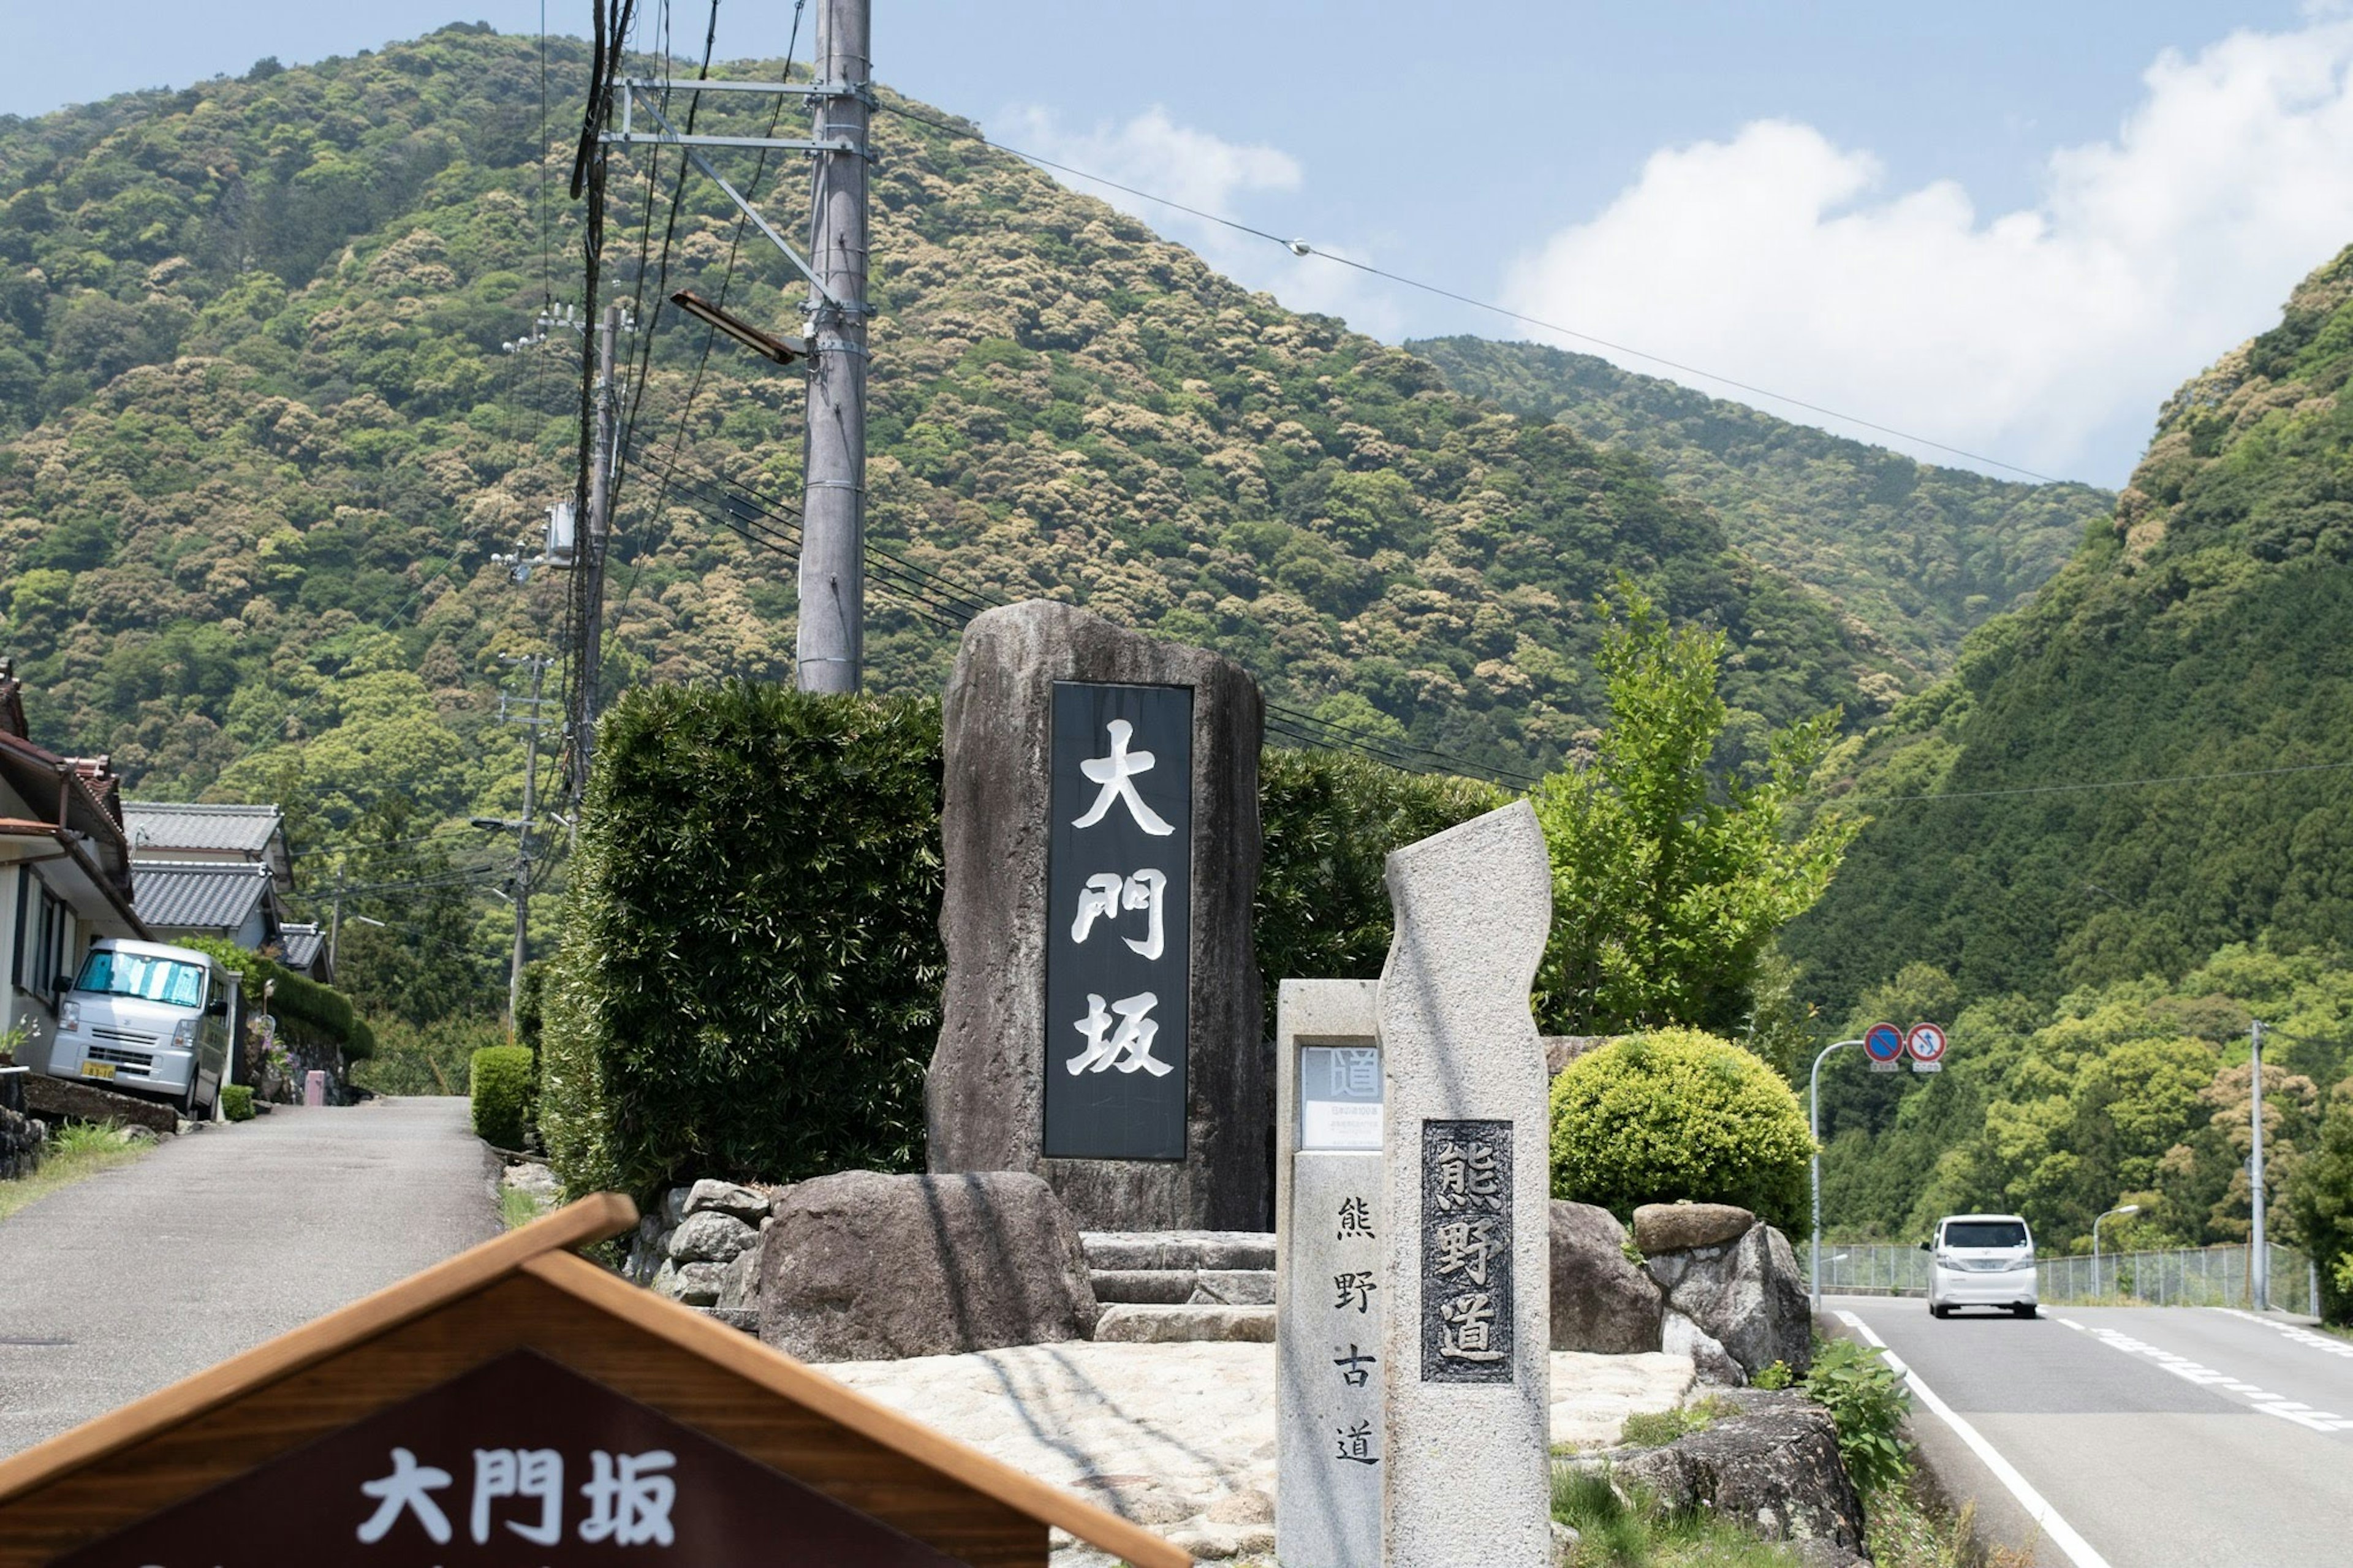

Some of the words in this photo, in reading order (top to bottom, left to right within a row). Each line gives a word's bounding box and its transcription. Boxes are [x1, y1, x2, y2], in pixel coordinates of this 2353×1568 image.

[1066, 719, 1176, 1077] 大門坂
[1330, 1047, 1378, 1097] 道
[1333, 1196, 1379, 1465] 熊野古道
[1434, 1140, 1506, 1362] 熊野道
[357, 1447, 676, 1547] 大門坂
